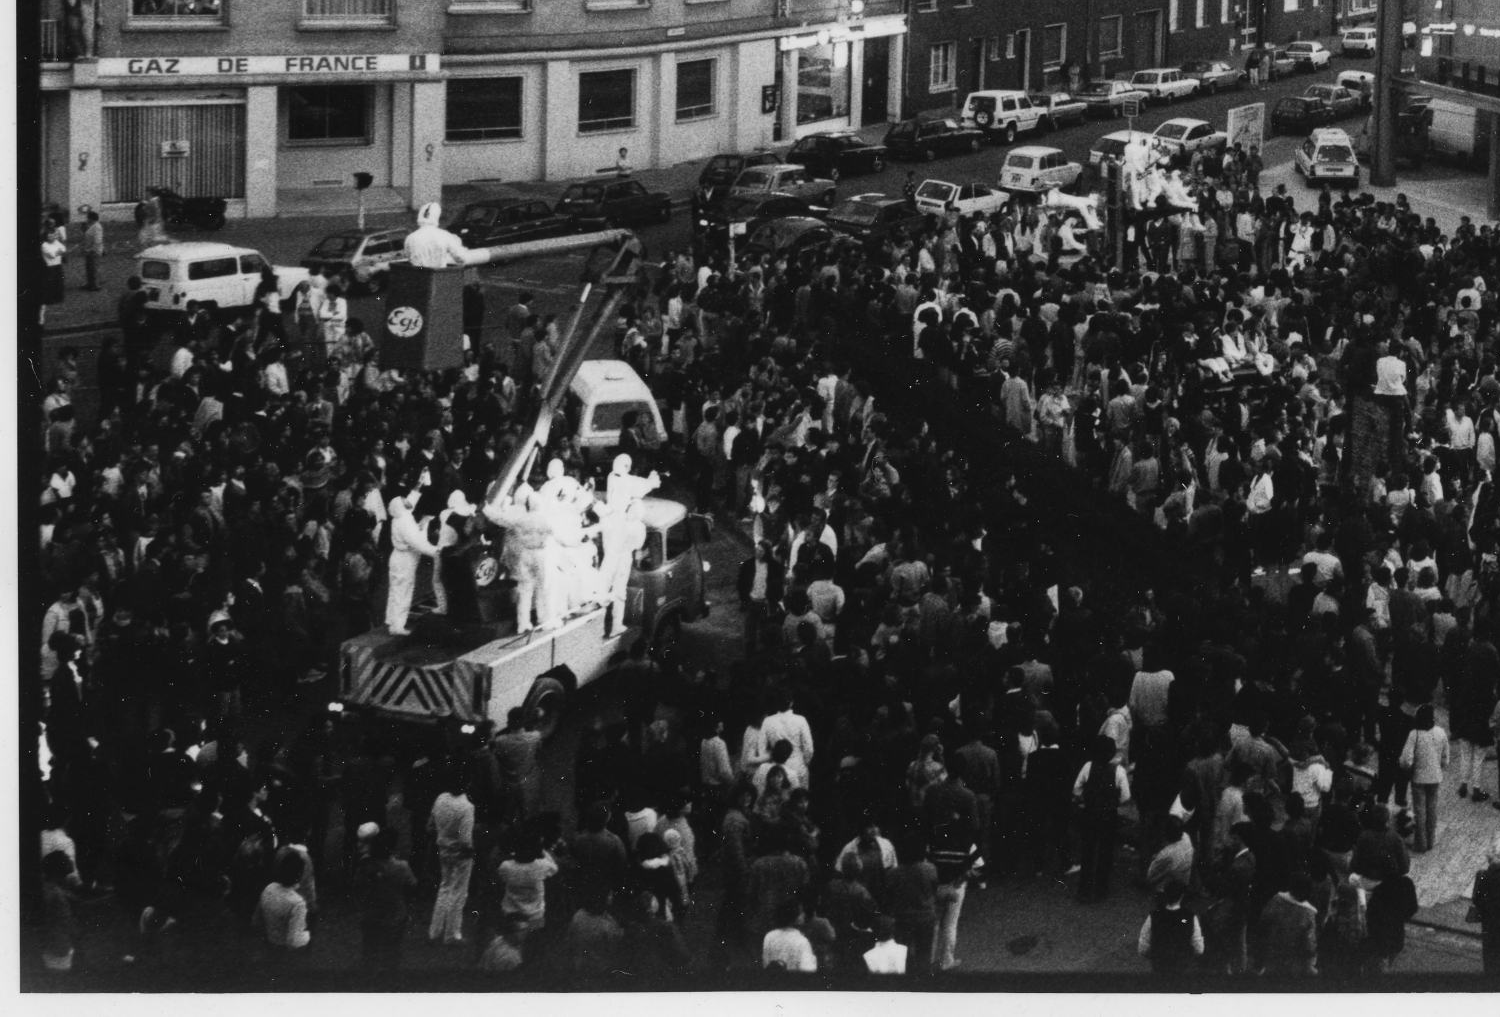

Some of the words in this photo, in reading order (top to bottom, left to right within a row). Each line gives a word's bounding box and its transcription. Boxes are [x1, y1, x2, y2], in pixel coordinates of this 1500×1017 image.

[127, 58, 181, 74] GAZ
[217, 57, 249, 73] DE
[285, 55, 378, 72] FRANCE
